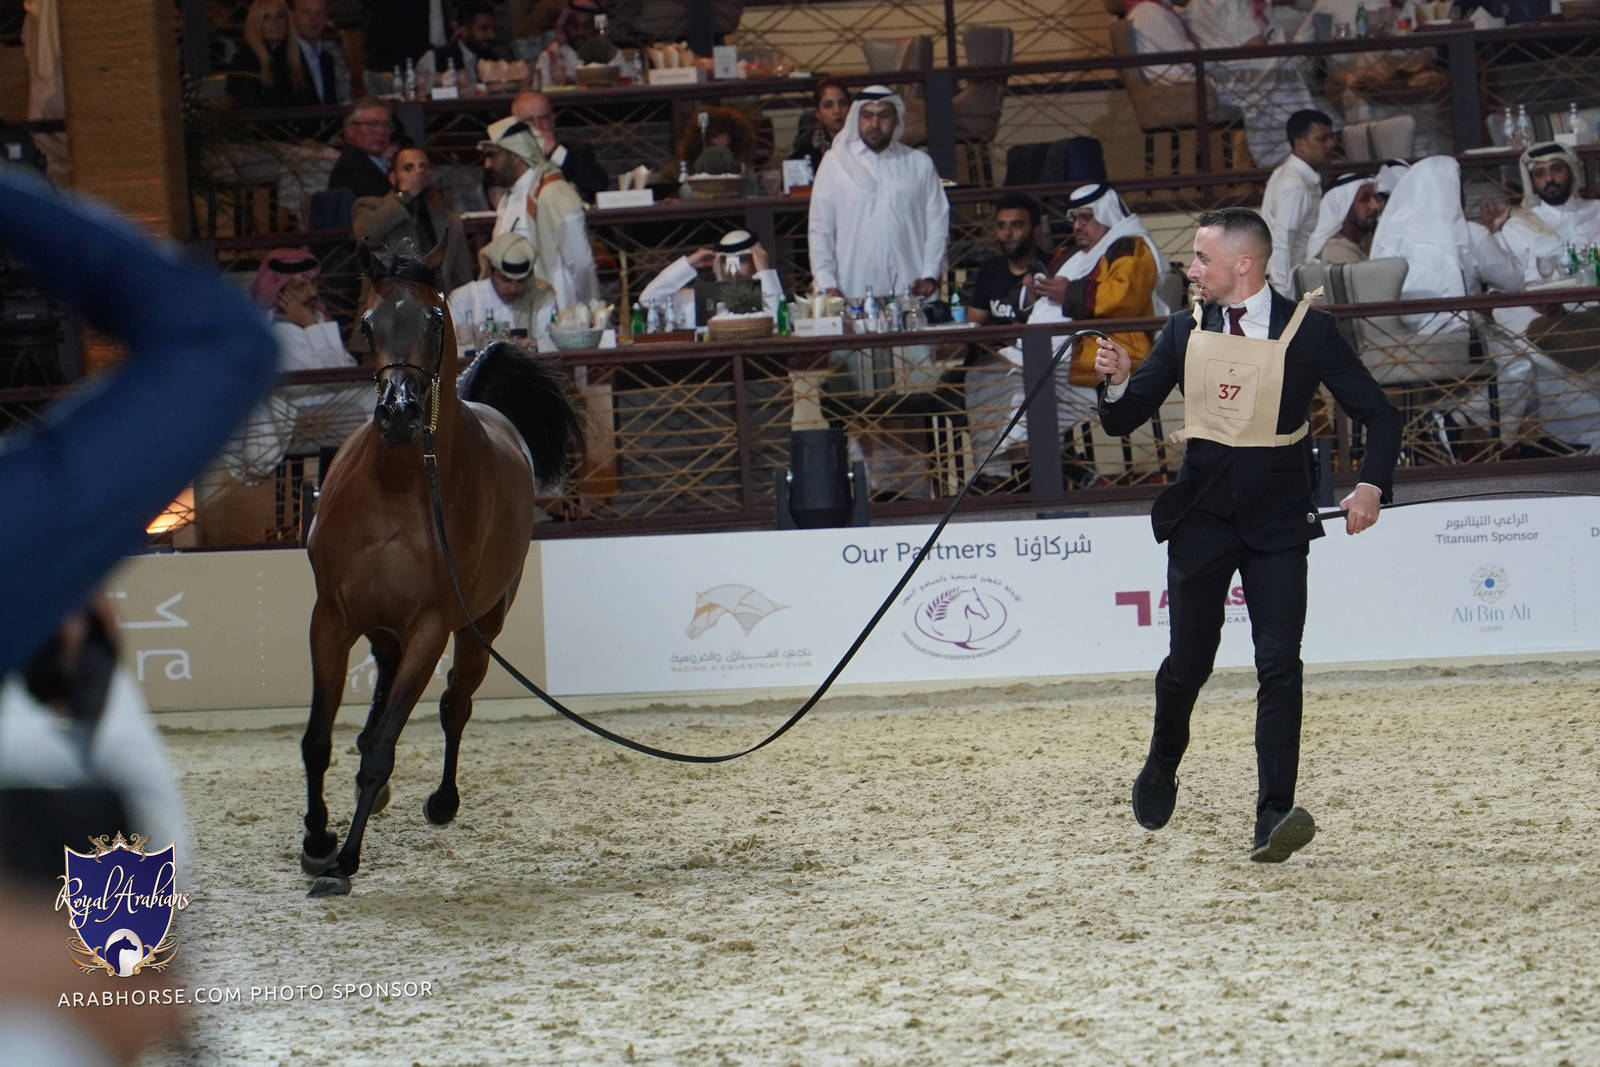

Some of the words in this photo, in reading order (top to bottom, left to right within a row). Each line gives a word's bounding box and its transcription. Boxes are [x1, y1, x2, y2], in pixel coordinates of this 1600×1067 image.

[1218, 383, 1242, 401] 37
[1493, 513, 1528, 528] الراعي
[1435, 533, 1488, 545] Titanium
[1491, 530, 1538, 545] Sponsor
[842, 544, 888, 564] Our
[1014, 534, 1091, 562] شركاؤنا
[1452, 606, 1473, 623] Ali
[1477, 604, 1504, 622] Bin
[1510, 603, 1531, 621] Ali
